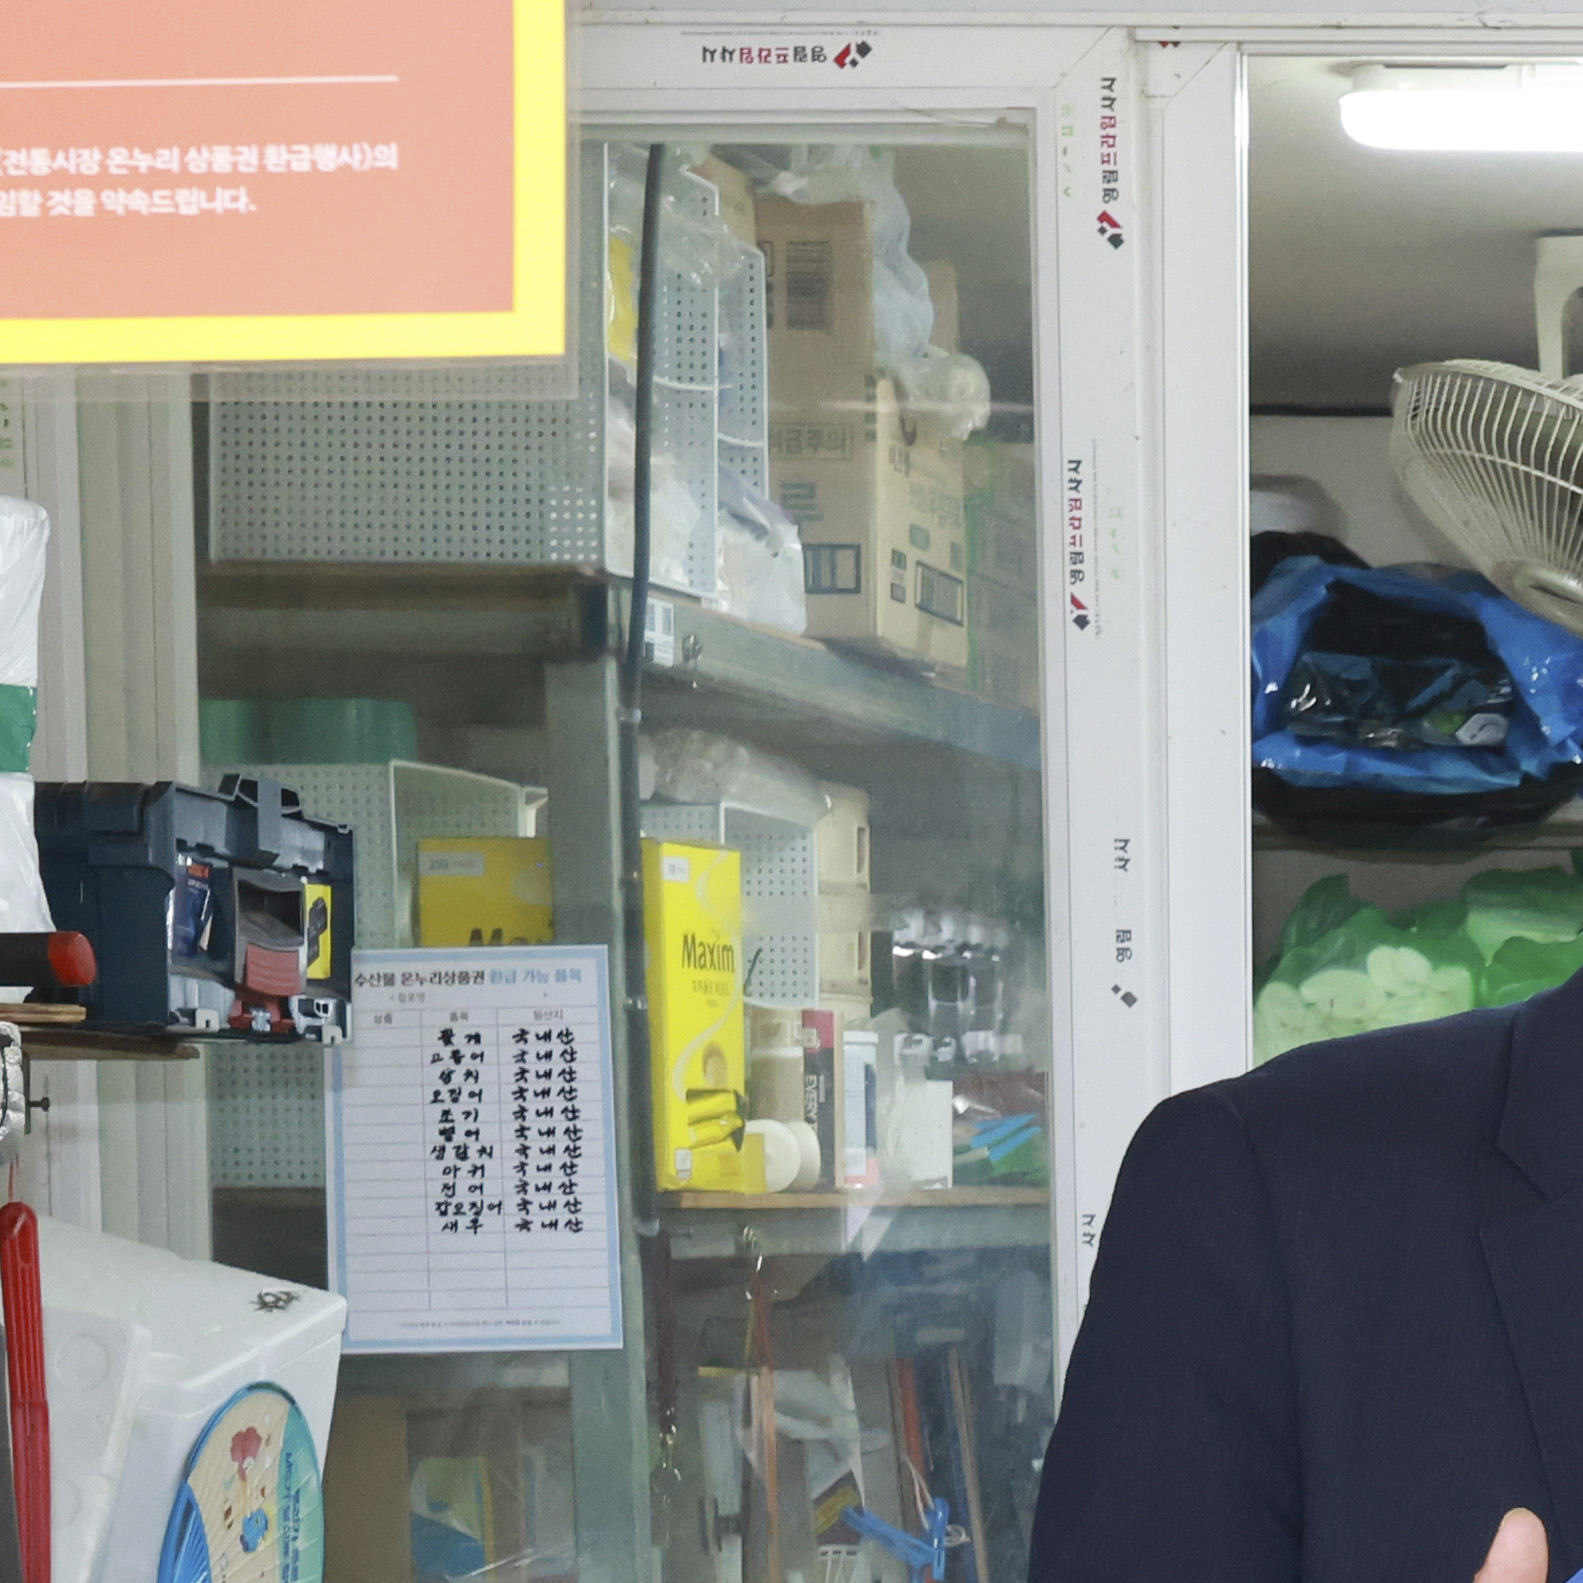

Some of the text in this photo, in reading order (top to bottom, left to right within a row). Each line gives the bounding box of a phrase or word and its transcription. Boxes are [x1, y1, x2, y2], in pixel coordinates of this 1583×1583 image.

[107, 147, 181, 174] 온누리
[185, 145, 258, 173] 상품권
[46, 189, 97, 218] 것을
[101, 186, 257, 216] 약속드립니다.
[681, 930, 735, 974] Maxim
[401, 969, 485, 986] 온누리상품권
